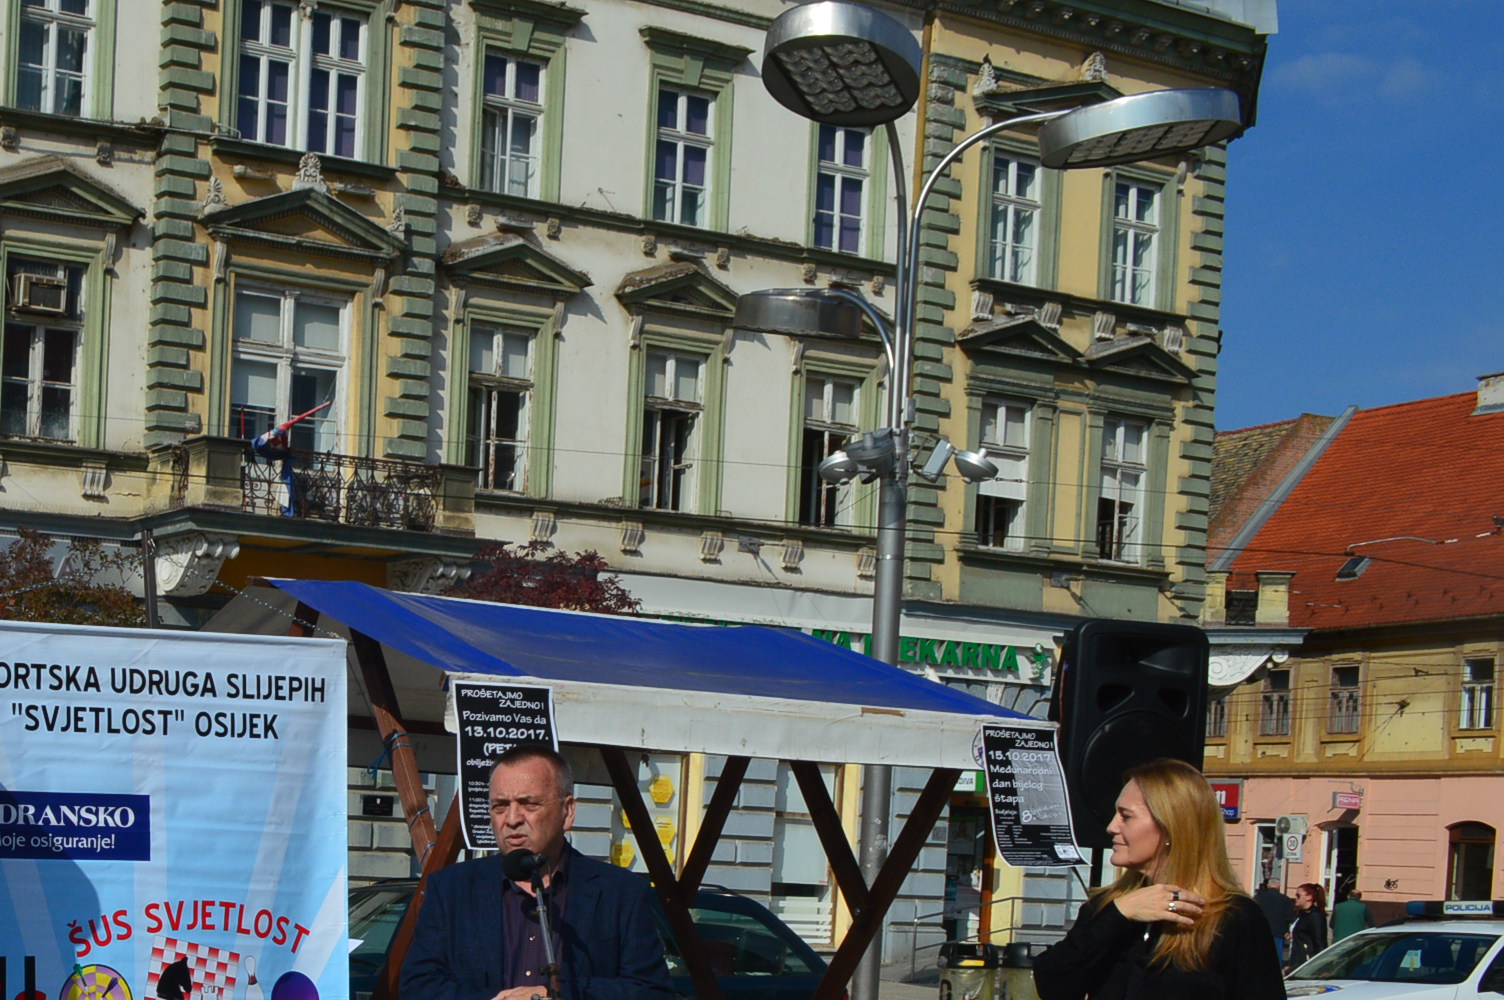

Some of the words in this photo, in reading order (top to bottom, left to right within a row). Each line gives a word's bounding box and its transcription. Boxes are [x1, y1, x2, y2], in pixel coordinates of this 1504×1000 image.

[110, 667, 217, 698] UDRUGA
[226, 673, 326, 703] SLIJEPIH
[461, 689, 523, 700] PROŠETAJMO
[11, 703, 186, 736] "SVJETLOST"
[195, 711, 279, 740] OSIJEK
[462, 711, 512, 722] Pozivamo
[513, 713, 532, 723] Vas
[534, 715, 546, 724] da
[464, 726, 549, 740] 13.10.2017.
[985, 729, 1036, 740] PROŠETAJMO
[483, 742, 517, 756] (PET
[990, 765, 1053, 775] Međunarodni
[992, 779, 1011, 788] dan
[1012, 780, 1043, 791] bijelog
[994, 794, 1025, 806] štapa
[30, 832, 116, 852] osiguranje!
[1446, 903, 1491, 912] POLICIJA
[66, 909, 133, 958] ŠUS
[144, 900, 311, 953] SVJETLOST
